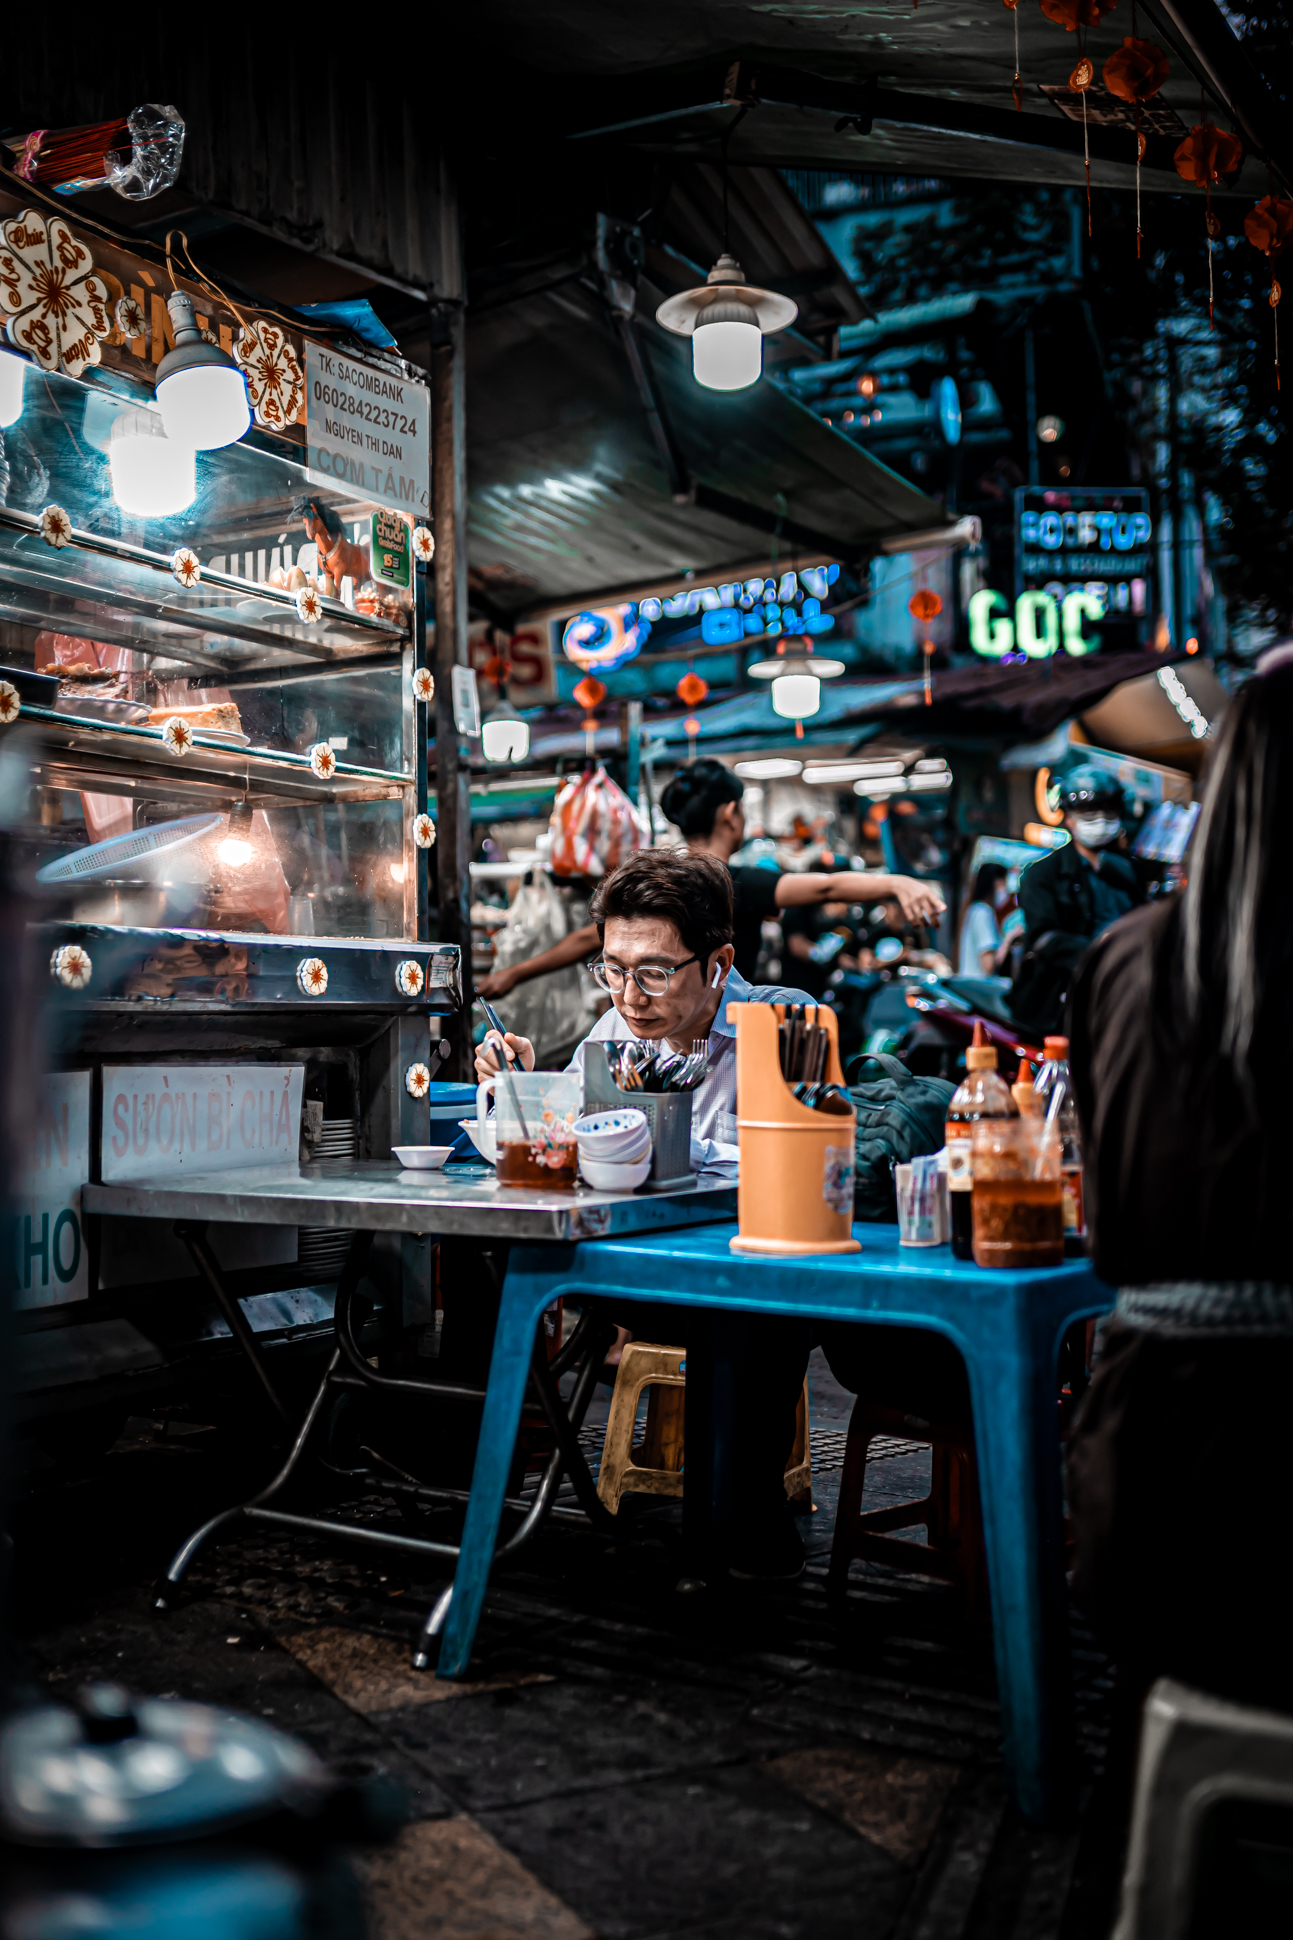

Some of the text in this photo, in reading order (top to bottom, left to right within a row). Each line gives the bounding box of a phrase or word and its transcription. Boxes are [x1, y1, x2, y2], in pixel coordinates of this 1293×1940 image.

[318, 353, 404, 404] TK: SACOMBANK
[313, 380, 418, 437] 060284223724
[325, 417, 403, 460] NGUYEN THI DAN
[317, 446, 416, 503] CƠM TẤM
[111, 1075, 198, 1158] SƯỜN
[207, 1074, 233, 1151] BÌ
[239, 1075, 293, 1149] CHẢ
[14, 1208, 81, 1290] HO
